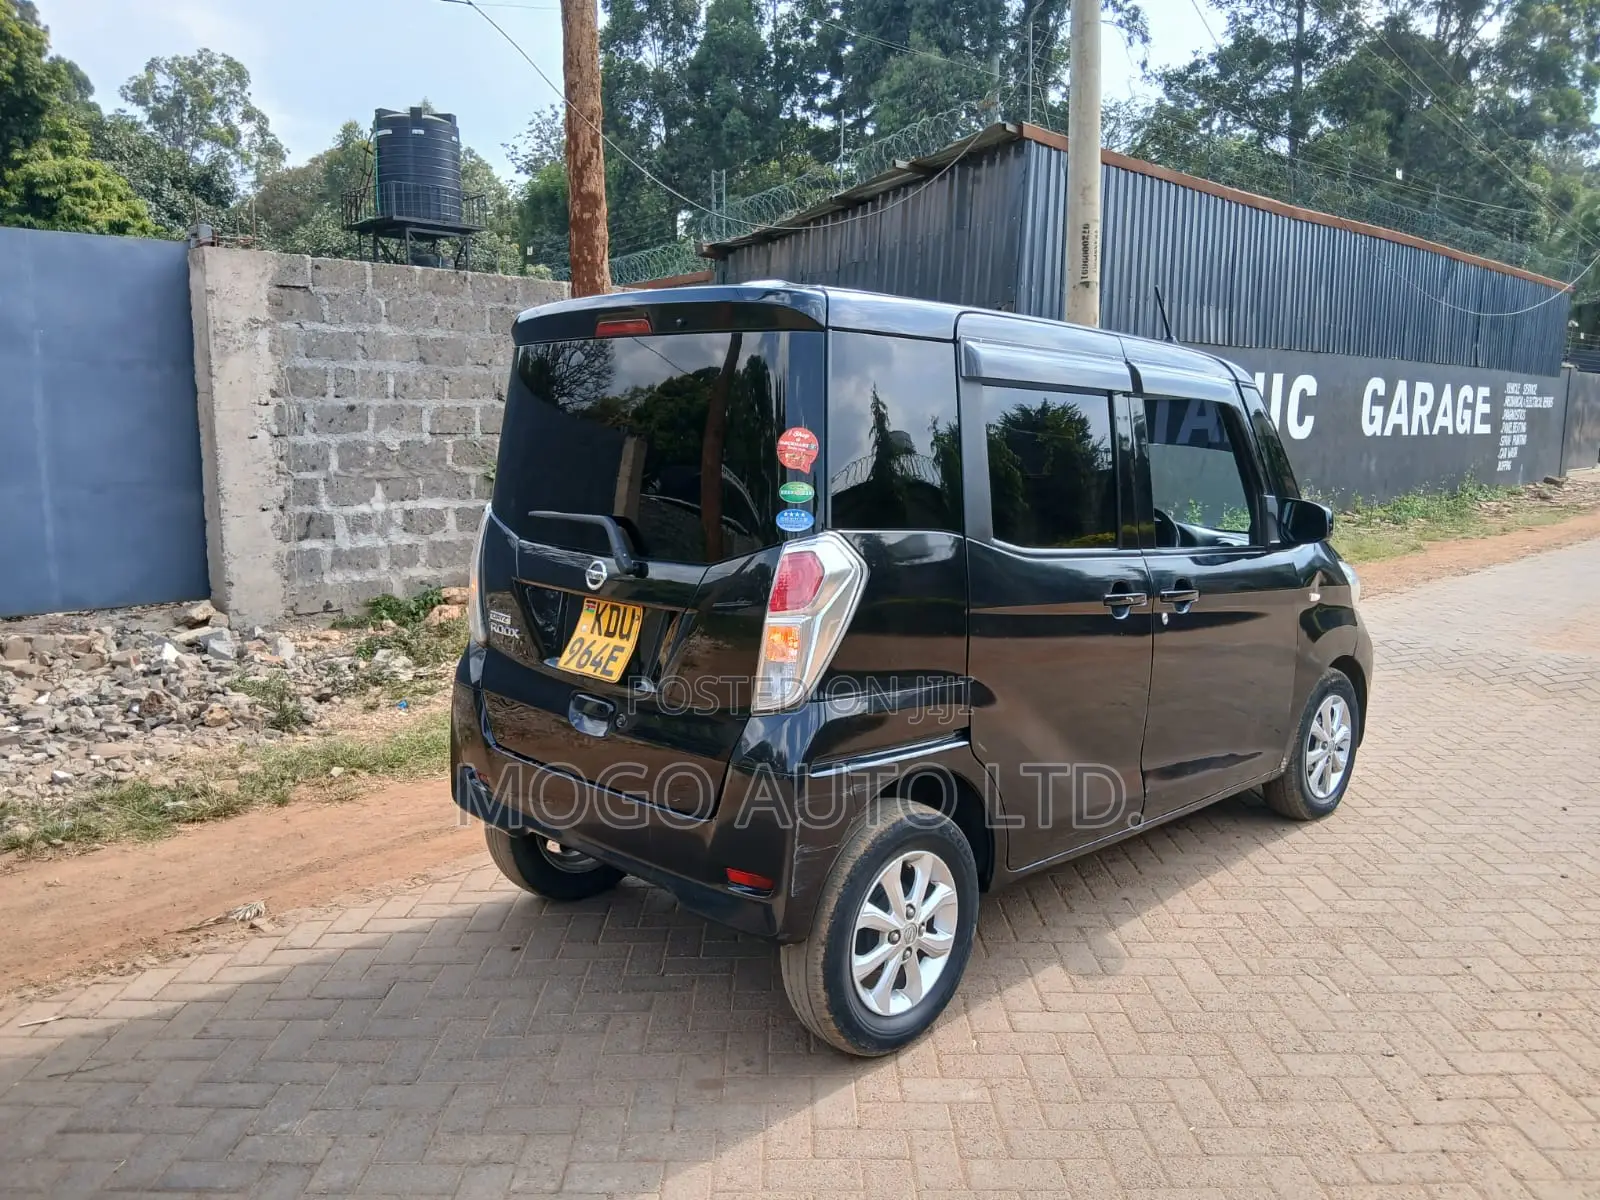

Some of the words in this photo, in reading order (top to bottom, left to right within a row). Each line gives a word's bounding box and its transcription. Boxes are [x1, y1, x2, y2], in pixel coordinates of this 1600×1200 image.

[1361, 375, 1492, 438] GARAGE
[490, 621, 521, 639] ROOX
[590, 602, 637, 642] KDU
[563, 636, 625, 678] 964E
